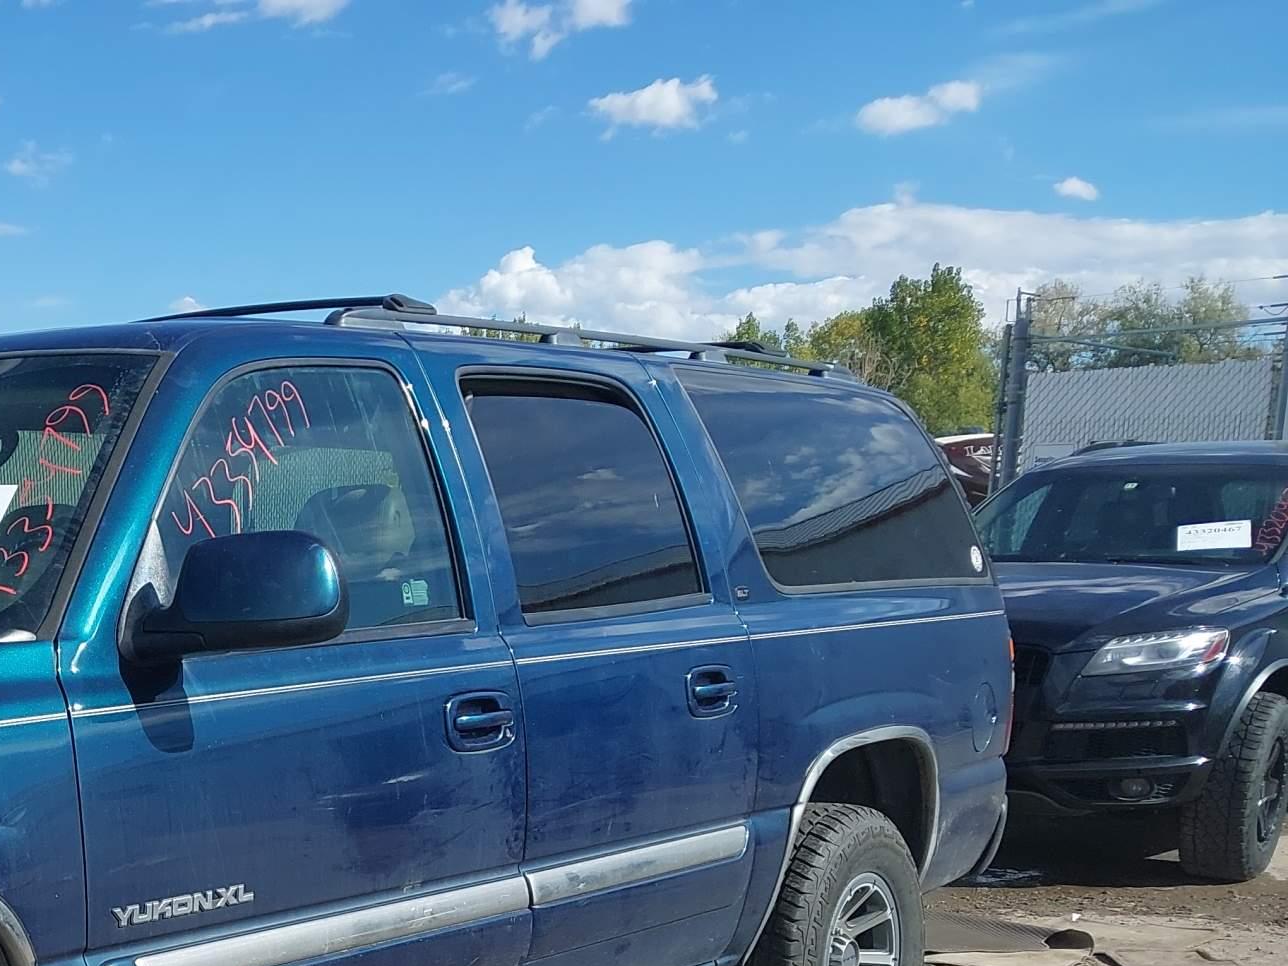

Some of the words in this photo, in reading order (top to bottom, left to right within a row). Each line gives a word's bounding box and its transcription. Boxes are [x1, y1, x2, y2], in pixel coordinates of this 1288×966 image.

[171, 381, 311, 539] 43354799
[112, 890, 213, 928] YUKON
[213, 884, 255, 908] XL
